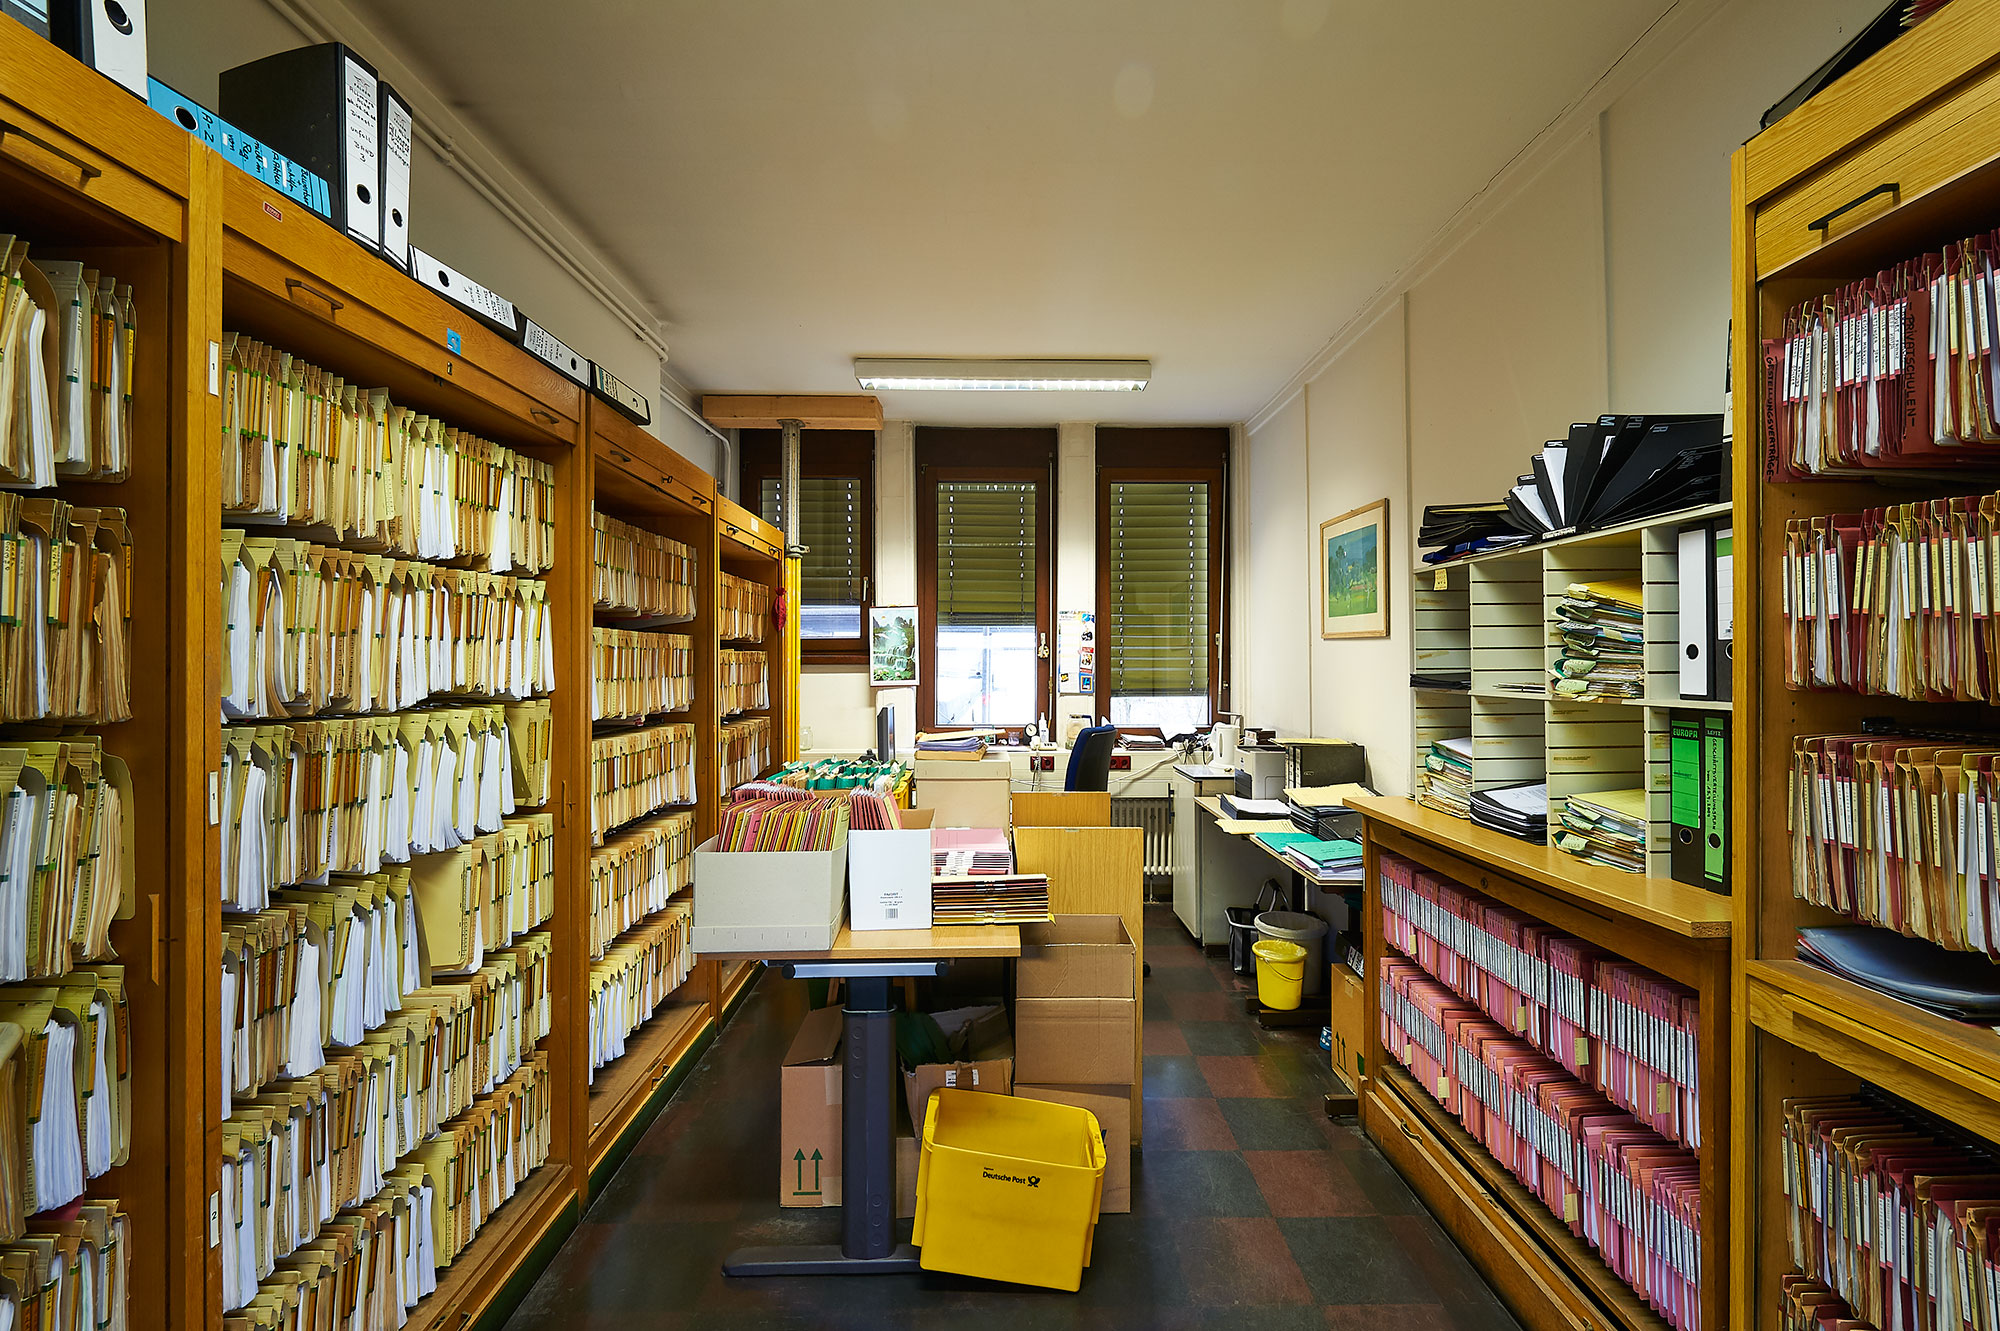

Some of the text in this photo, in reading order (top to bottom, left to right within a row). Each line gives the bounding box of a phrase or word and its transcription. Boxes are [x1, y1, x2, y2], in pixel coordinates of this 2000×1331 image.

[359, 153, 366, 163] 3
[1600, 416, 1616, 426] M
[1672, 727, 1698, 738] EUROPA
[982, 1171, 1026, 1184] Deutsche Post
[212, 1211, 217, 1220] 2
